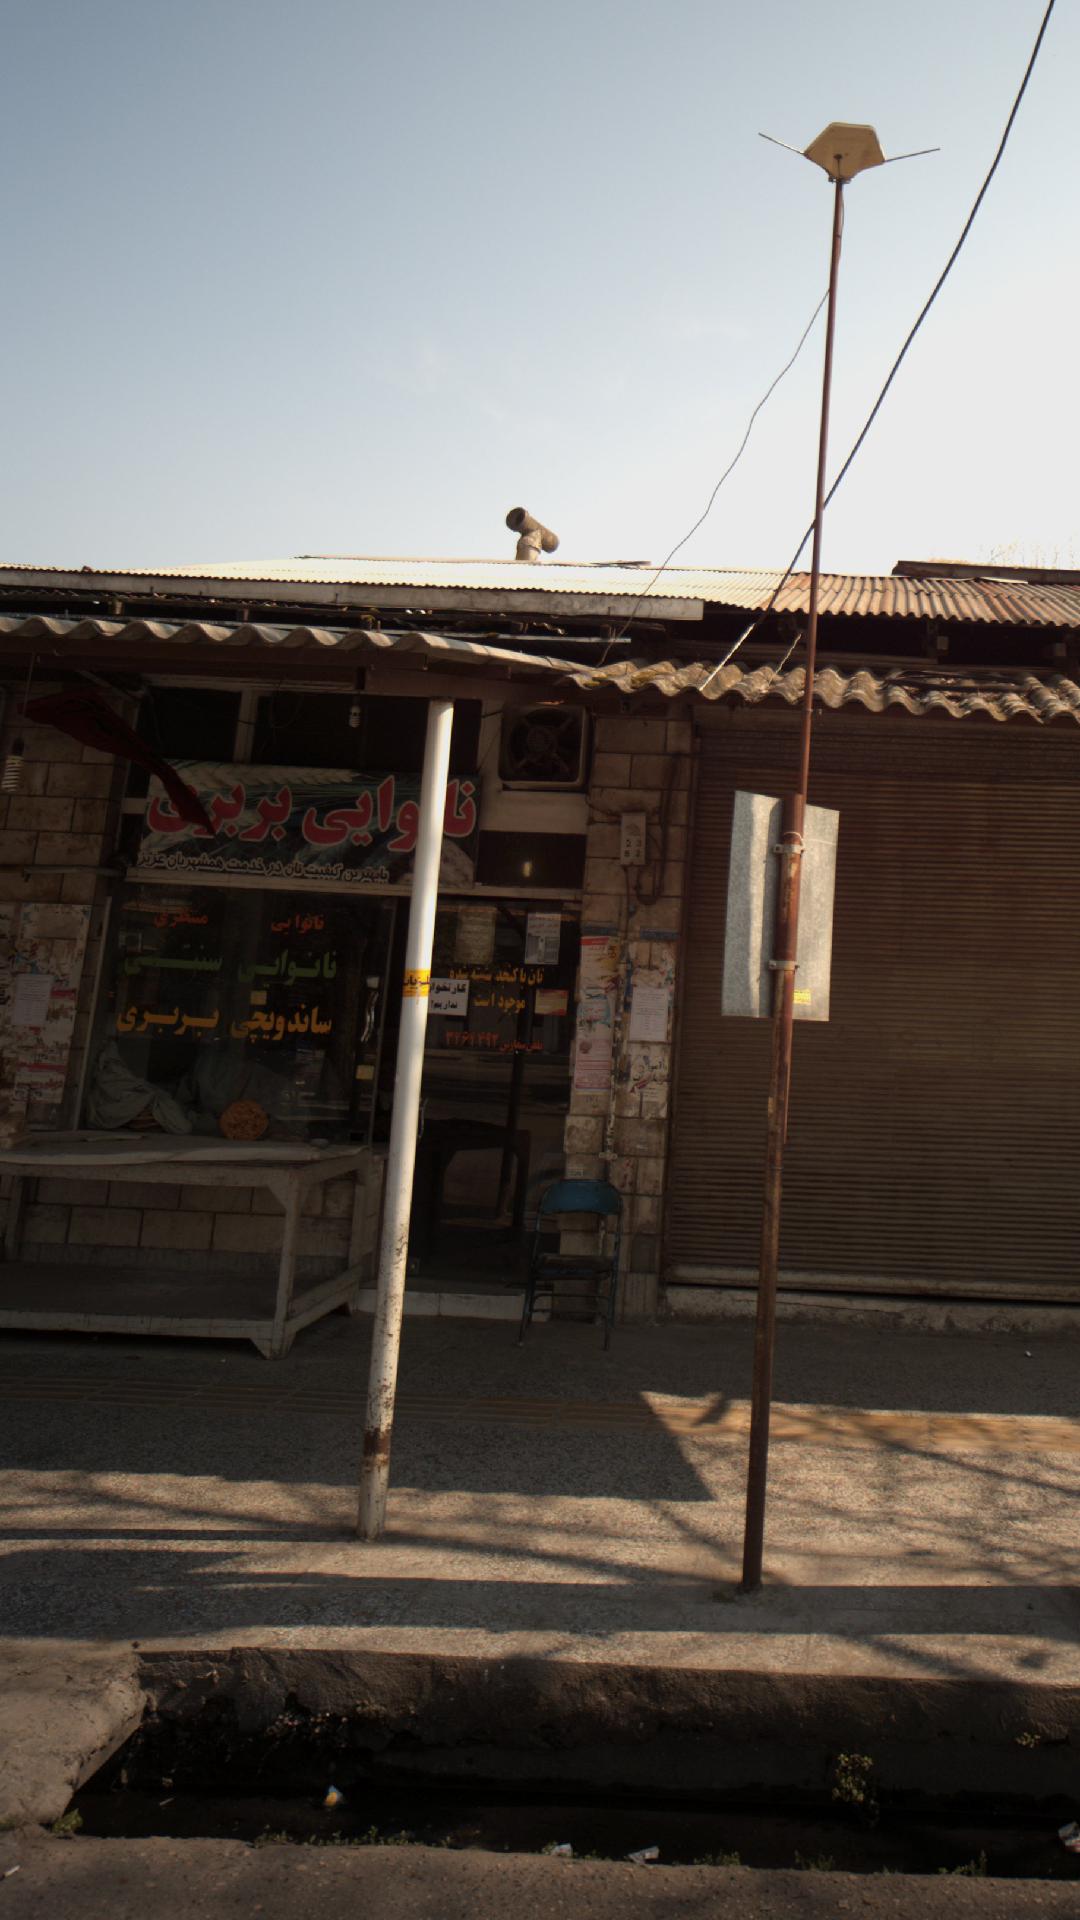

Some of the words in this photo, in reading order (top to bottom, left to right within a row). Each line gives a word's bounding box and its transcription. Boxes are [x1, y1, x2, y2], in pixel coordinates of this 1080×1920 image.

[302, 774, 477, 853] ناوایی
[136, 848, 166, 868] عزیز
[167, 850, 225, 871] همشهریان
[225, 856, 265, 875] خدمت
[266, 860, 283, 877] در
[284, 860, 304, 879] نان
[272, 911, 326, 936] نانوایی
[239, 948, 337, 988] نانوایی
[518, 967, 528, 990] با
[527, 967, 545, 987] نان
[432, 981, 467, 995] کارتخوا
[472, 991, 497, 1008] است
[497, 994, 527, 1017] موجود
[116, 1004, 222, 1038] بربری
[230, 1002, 334, 1044] ساندویچی
